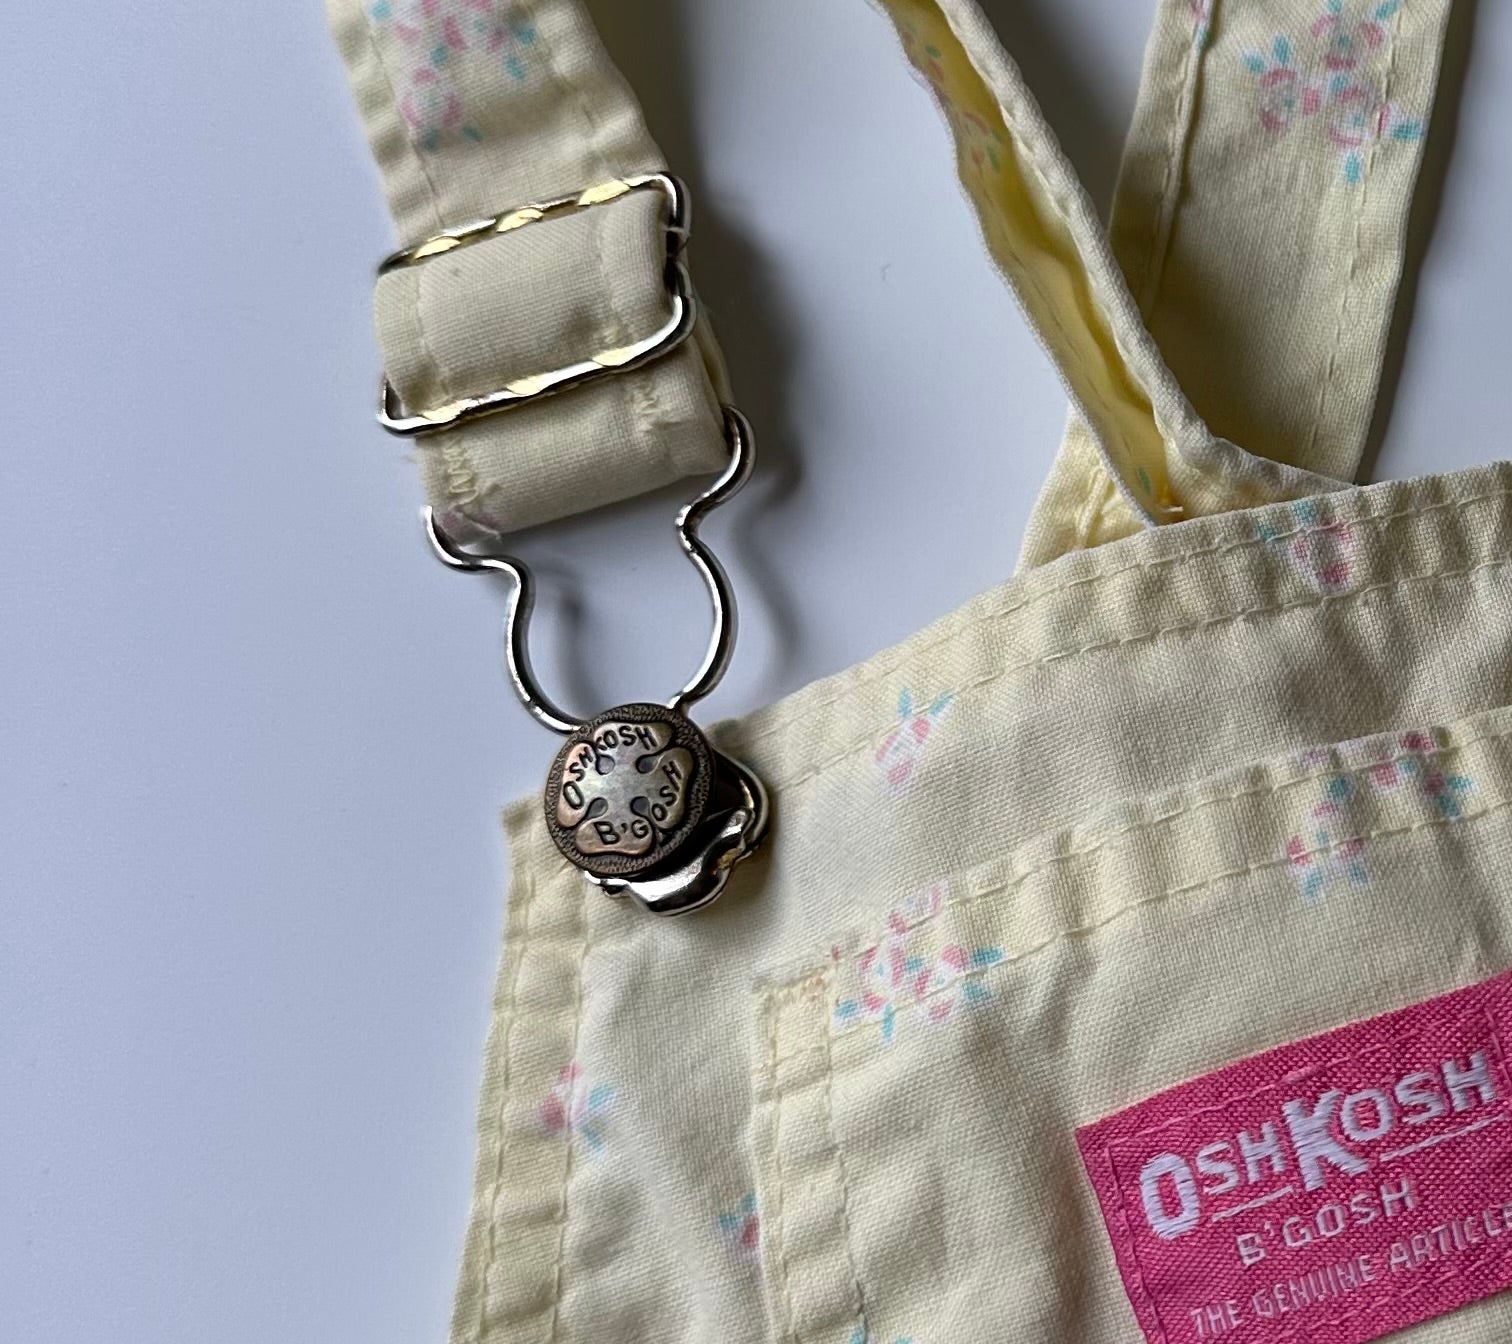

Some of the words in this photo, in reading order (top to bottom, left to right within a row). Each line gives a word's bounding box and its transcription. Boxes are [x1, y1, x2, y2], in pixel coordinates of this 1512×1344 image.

[563, 724, 658, 810] OSHKOSH
[594, 760, 683, 845] B'GOSH
[1138, 1049, 1498, 1241] OSHKOSH
[1235, 1177, 1420, 1268] B'GOSH
[1190, 1298, 1244, 1340] THE
[1252, 1254, 1377, 1318] GENUINE
